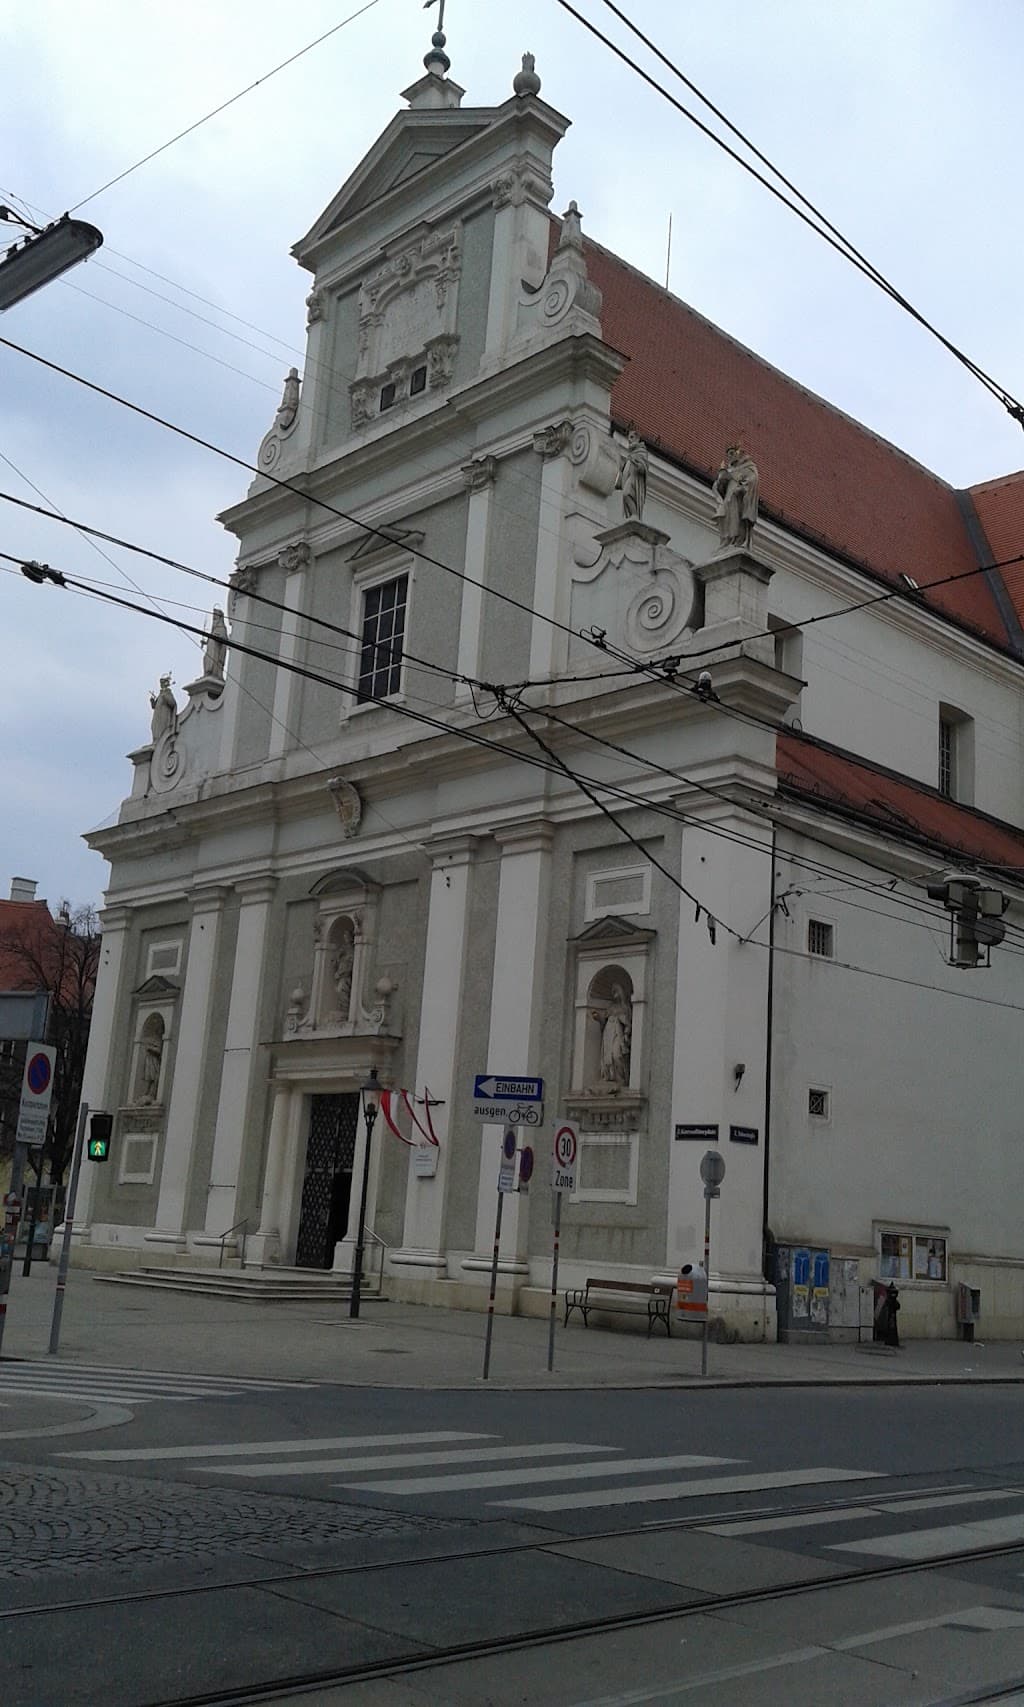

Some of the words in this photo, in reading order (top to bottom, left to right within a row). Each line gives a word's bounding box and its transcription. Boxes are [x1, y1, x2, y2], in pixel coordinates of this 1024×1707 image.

[495, 1082, 535, 1094] EINBAHN
[474, 1106, 508, 1118] ausgen.
[561, 1138, 571, 1157] 30
[555, 1170, 573, 1188] Zone
